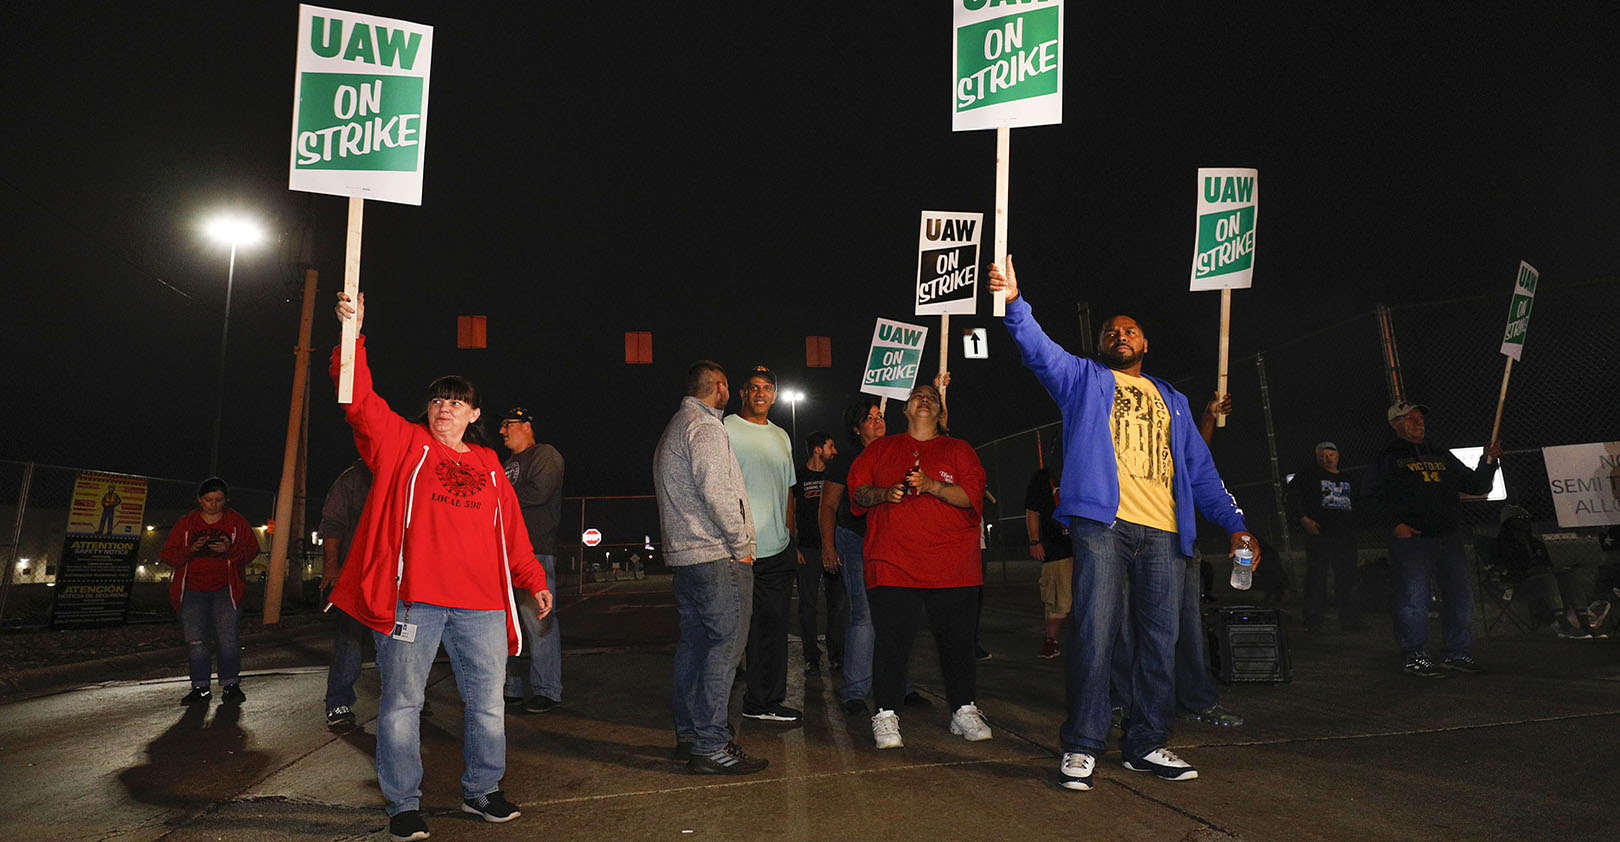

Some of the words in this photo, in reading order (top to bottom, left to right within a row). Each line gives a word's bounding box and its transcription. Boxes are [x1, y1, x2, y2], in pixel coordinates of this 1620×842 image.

[311, 16, 423, 70] UAW
[984, 17, 1023, 60] ON
[958, 39, 1057, 108] STRIKE
[334, 79, 383, 119] ON
[297, 113, 420, 165] STRIKE
[1204, 176, 1254, 203] UAW
[926, 218, 976, 242] UAW
[1216, 211, 1240, 242] ON
[936, 249, 959, 275] ON
[1197, 230, 1254, 276] STRIKE
[919, 264, 976, 303] STRIKE
[878, 323, 922, 347] UAW
[882, 350, 904, 366] ON
[865, 364, 917, 384] STRIKE
[1407, 462, 1447, 471] VICTORS
[1600, 454, 1620, 469] N
[1551, 477, 1603, 494] SEMI
[432, 493, 460, 506] LOCAL
[72, 540, 134, 550] ATTENTION
[64, 584, 125, 594] ATENCIÓN
